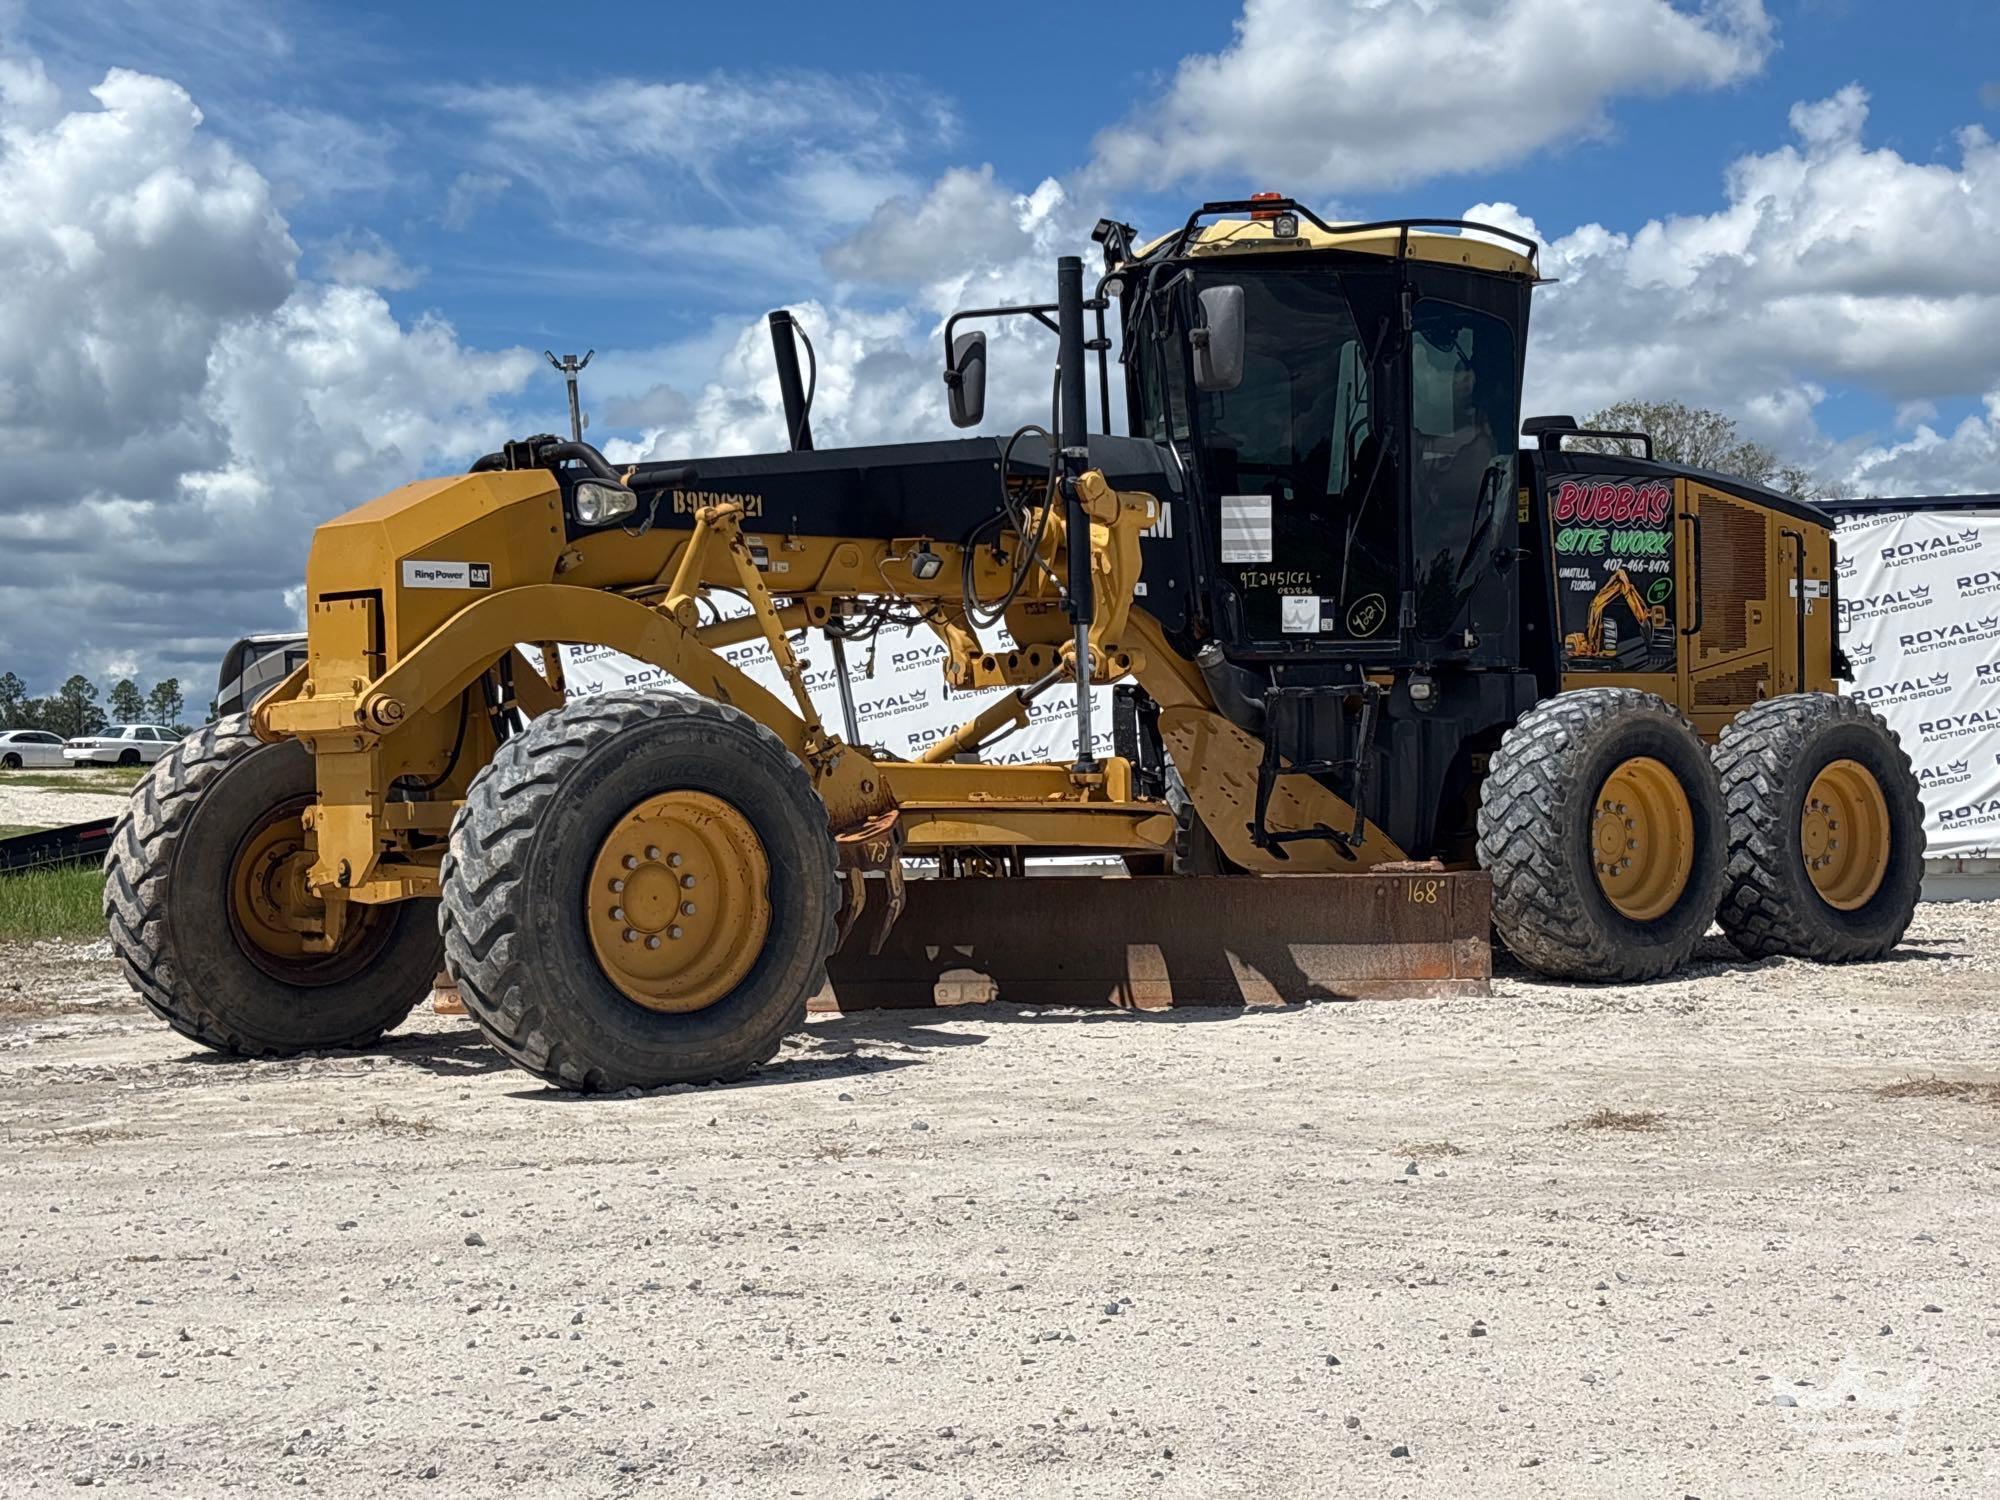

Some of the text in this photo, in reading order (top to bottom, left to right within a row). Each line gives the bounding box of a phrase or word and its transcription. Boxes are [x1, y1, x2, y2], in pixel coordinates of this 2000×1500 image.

[1555, 481, 1671, 528] BUBBA'S
[1139, 502, 1173, 538] M
[1832, 521, 1870, 535] CTION
[1555, 528, 1673, 557] SITE WORK
[1881, 535, 1959, 560] ROYAL
[1884, 542, 1983, 569] AUCTION GROUP
[414, 569, 488, 582] Ring Power CAT
[1957, 571, 2000, 590] ROY
[1570, 580, 1596, 591] FLORIDA
[1960, 584, 2000, 598] AUCTI
[1838, 591, 1910, 614] ROYAL
[1890, 598, 1933, 613] GROUP
[878, 624, 907, 635] GROU
[1900, 621, 1979, 647] ROYAL
[1903, 630, 2000, 656] AUCTION GROUP
[573, 651, 616, 665] AUCTION
[726, 644, 771, 662] ROY
[736, 655, 773, 668] UCTION
[892, 644, 947, 665] ROYA
[1851, 656, 1876, 666] OUP
[895, 657, 940, 672] AUCTION
[624, 667, 668, 686] ROY
[806, 682, 836, 693] CTION
[1851, 678, 1929, 702] ROYAL
[1870, 686, 1952, 708] CTION GROUP
[854, 694, 910, 714] OYAL
[856, 701, 929, 723] UCTION GROUP
[1028, 698, 1078, 717] OYAL
[1031, 714, 1063, 726] CTION
[1919, 710, 1998, 734] ROYAL
[908, 723, 966, 744] ROYA
[1072, 731, 1113, 750] ROY
[1922, 727, 1976, 743] AUCTION
[911, 741, 940, 752] AUCT
[1929, 774, 1972, 788] GROUP
[1939, 800, 2000, 822] ROYA
[1942, 814, 1996, 831] AUCTION
